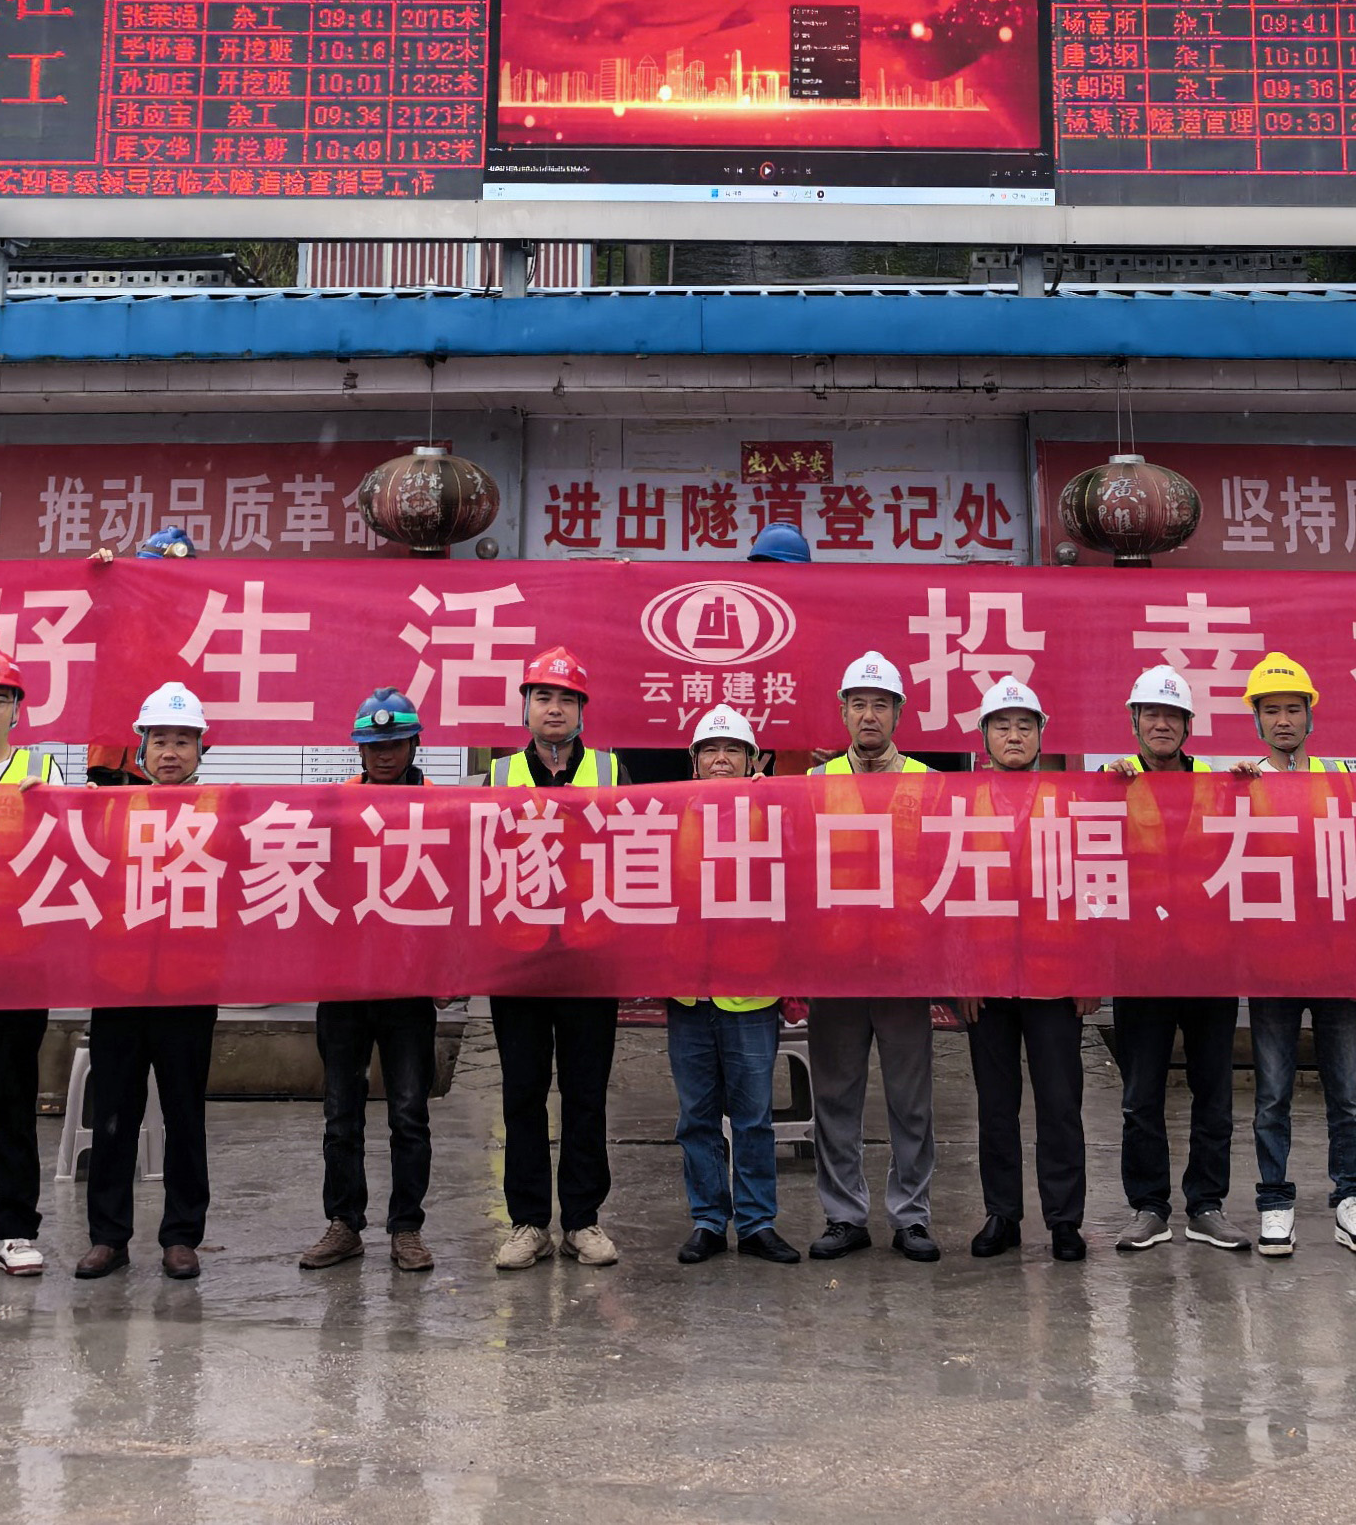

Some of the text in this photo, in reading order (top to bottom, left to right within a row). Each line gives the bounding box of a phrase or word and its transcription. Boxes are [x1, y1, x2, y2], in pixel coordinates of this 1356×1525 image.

[232, 5, 282, 30] 杂工
[318, 71, 382, 96] 10:01
[228, 102, 277, 127] 杂工
[748, 450, 826, 473] 出入平安
[544, 480, 1014, 551] 进出隧道登记处
[640, 671, 797, 706] 云南建投
